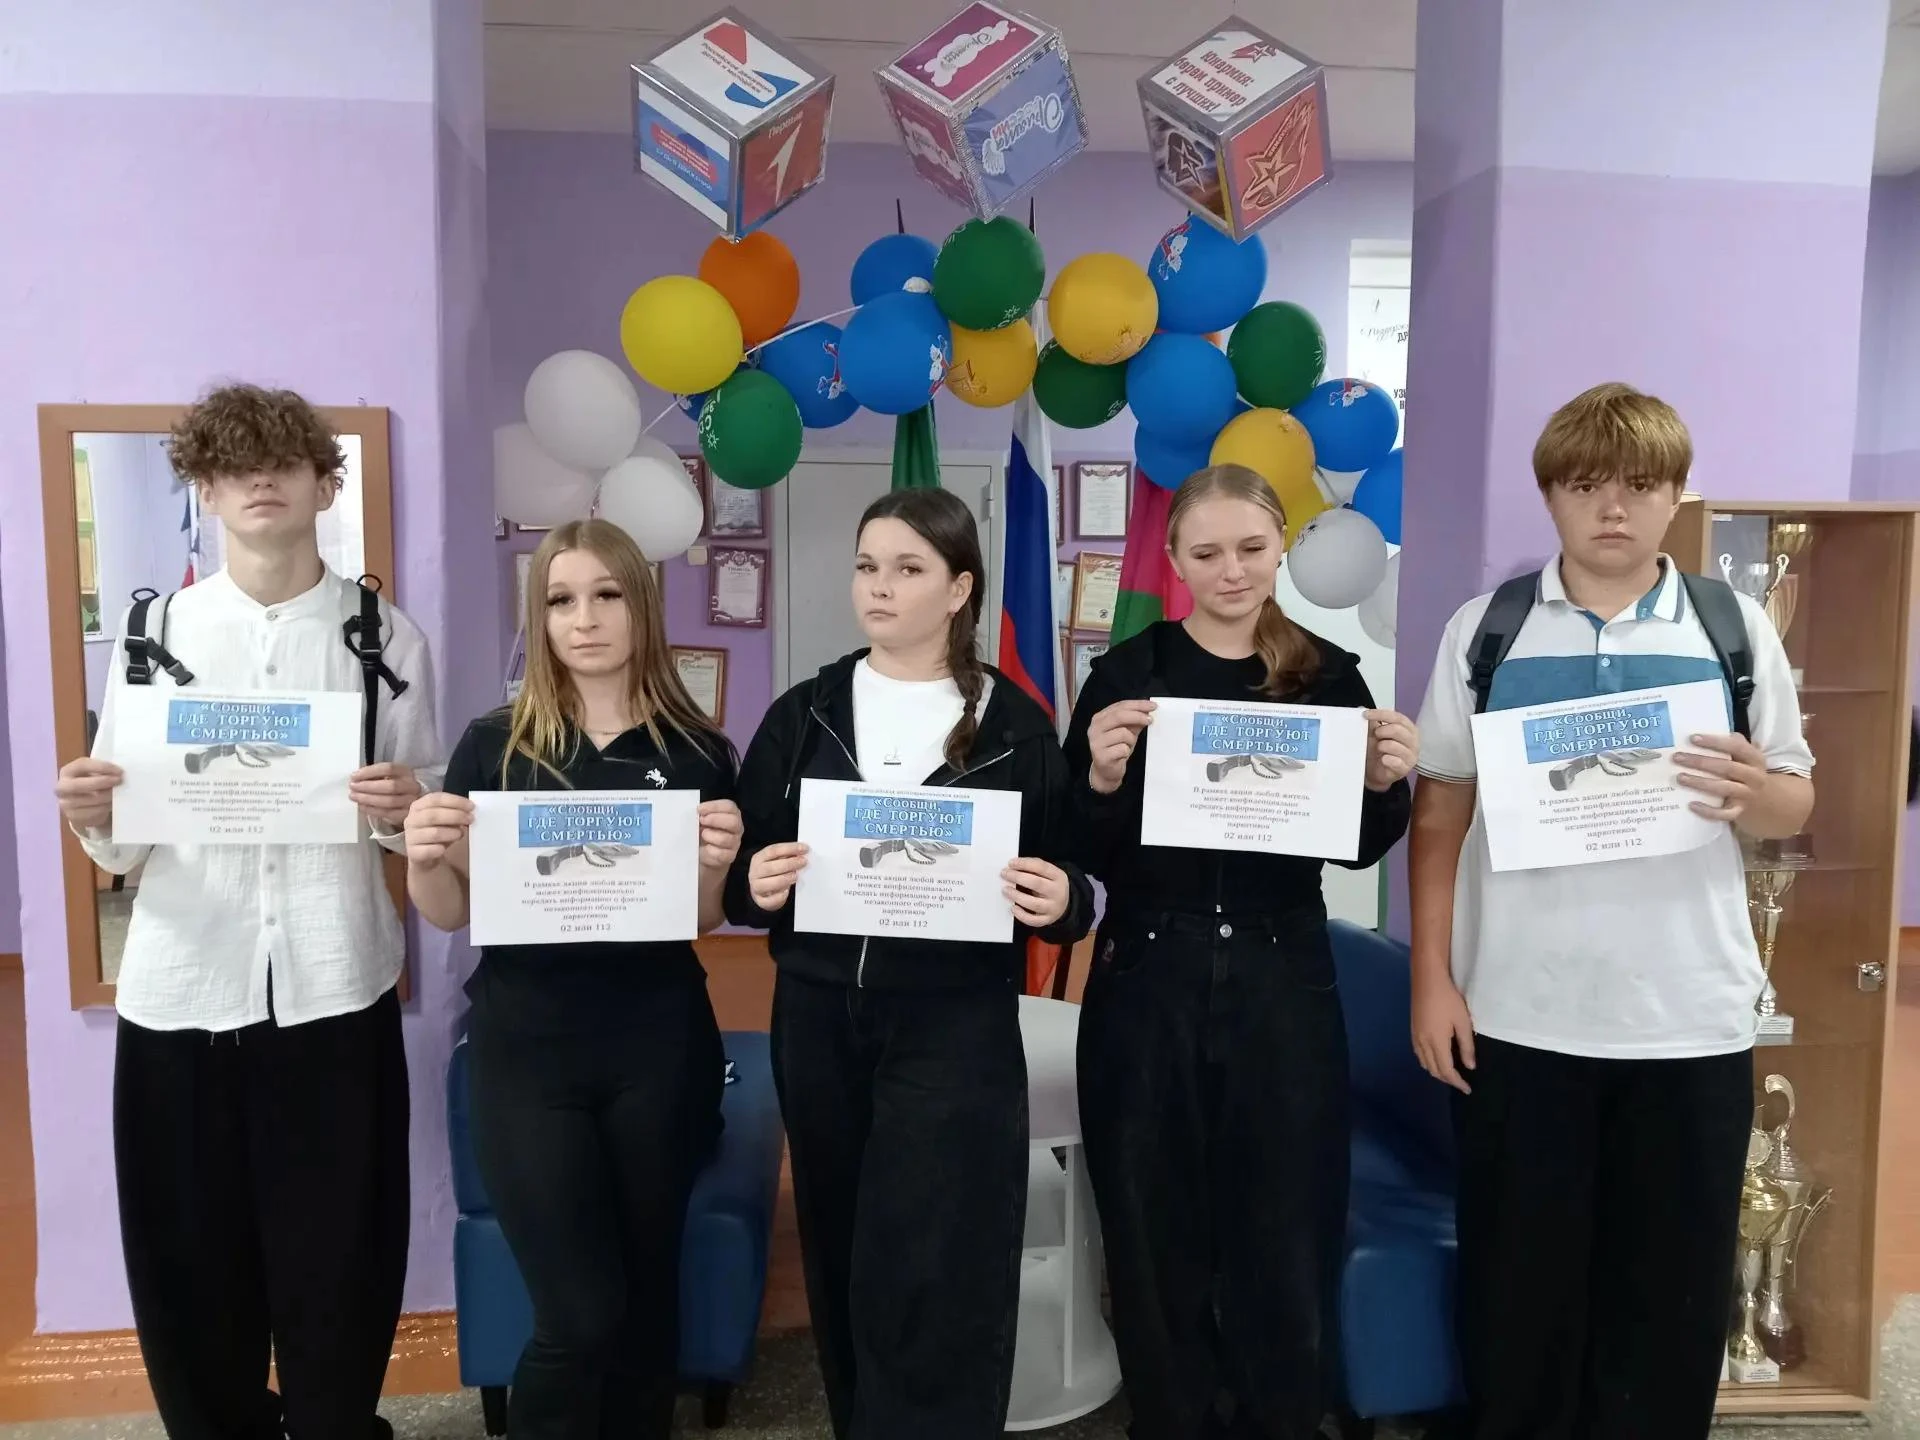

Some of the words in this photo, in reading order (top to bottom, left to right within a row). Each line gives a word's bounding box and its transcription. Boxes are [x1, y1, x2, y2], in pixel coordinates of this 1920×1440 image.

[177, 714, 208, 726] ГДЕ
[218, 715, 301, 726] ТОРГУЮТ
[190, 728, 288, 739] СМЕРТЬЮ»
[1201, 725, 1227, 737] ГДЕ
[1236, 727, 1311, 740] ТОРГУЮТ
[1534, 728, 1565, 744] ГДЕ
[1574, 715, 1661, 737] ТОРГУЮТ
[1211, 738, 1299, 753] СМЕРТЬЮ»
[1548, 731, 1650, 754] СМЕРТЬЮ»
[528, 817, 556, 829] ГДЕ
[566, 816, 643, 826] ТОРГУЮТ
[853, 808, 881, 821] ГДЕ
[890, 810, 964, 824] ТОРГУЮТ
[540, 829, 631, 840] СМЕРТЬЮ»
[864, 822, 952, 837] СМЕРТЬЮ»
[1585, 842, 1598, 851] 02
[1601, 841, 1620, 849] или
[1624, 837, 1643, 846] 112
[913, 920, 927, 928] 112
